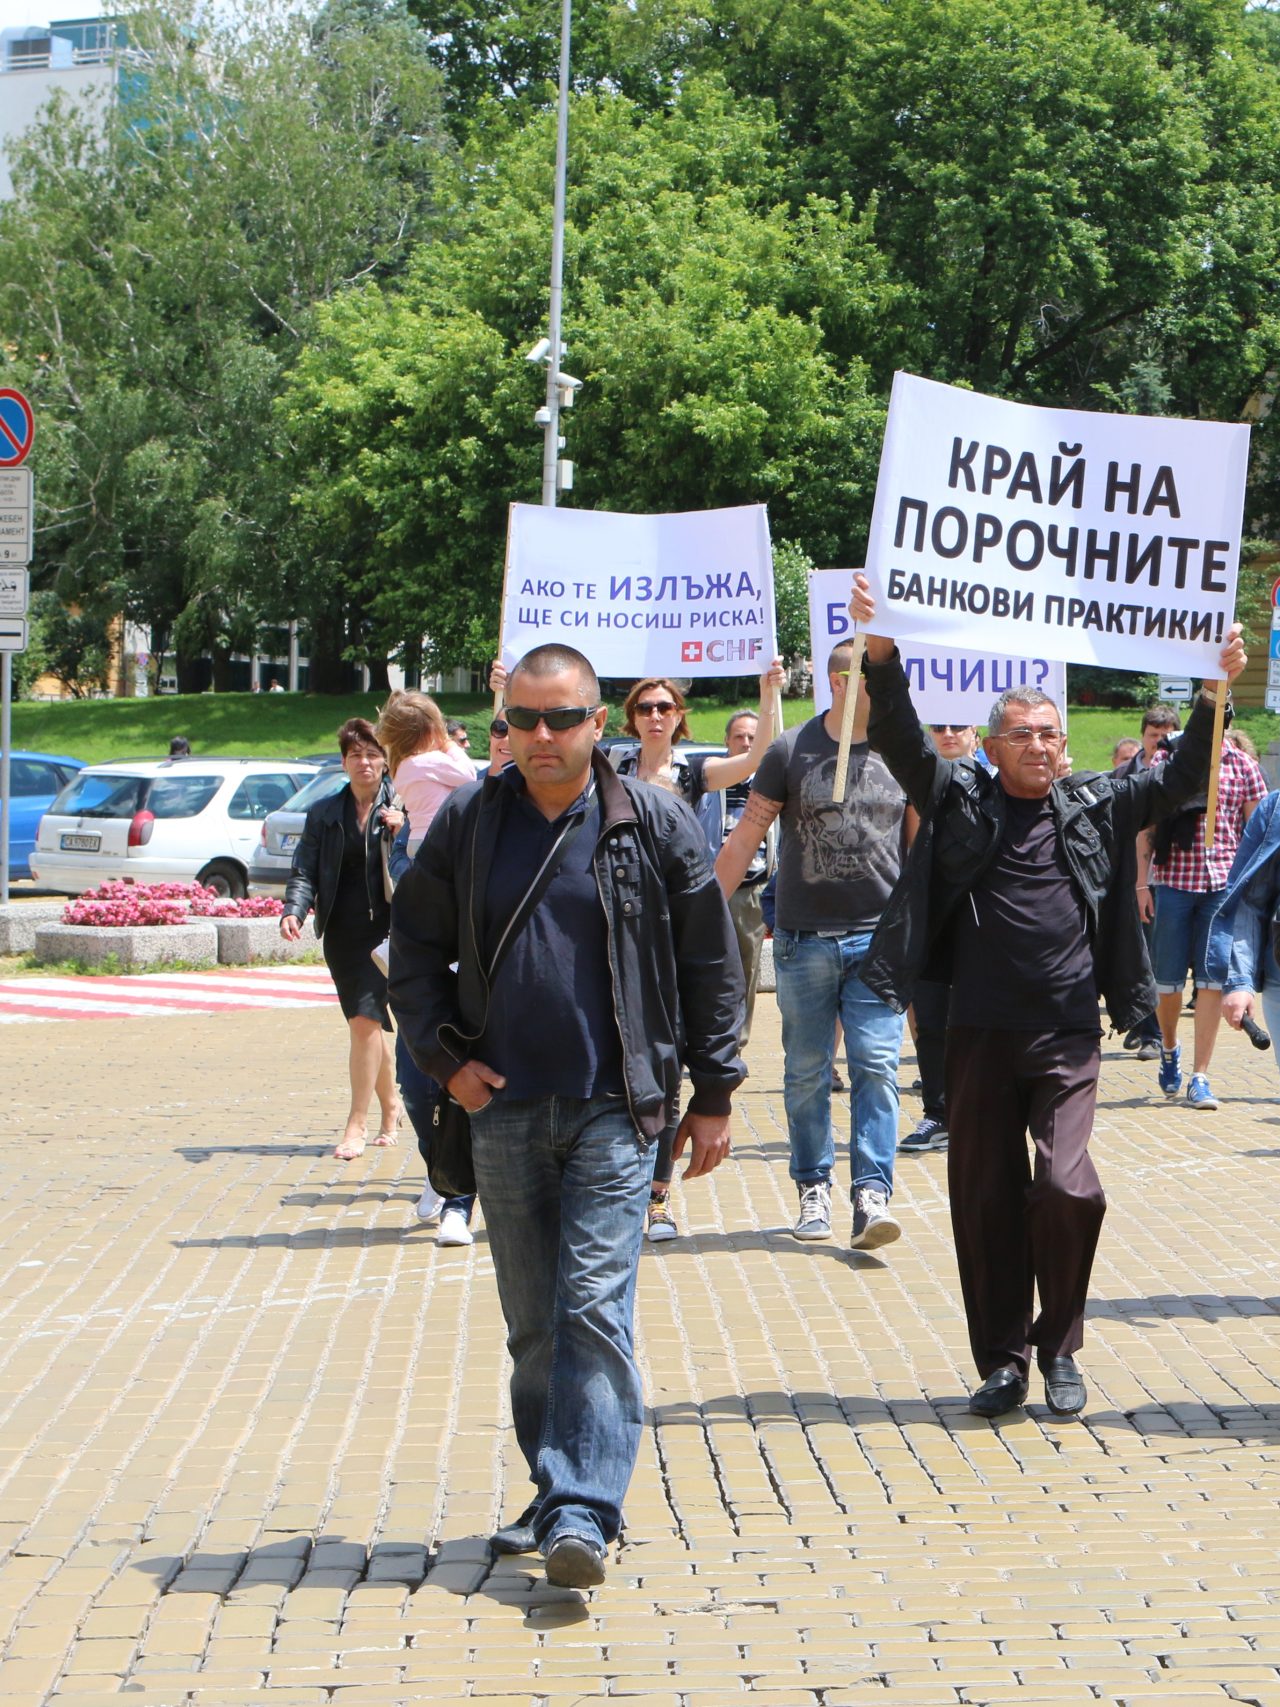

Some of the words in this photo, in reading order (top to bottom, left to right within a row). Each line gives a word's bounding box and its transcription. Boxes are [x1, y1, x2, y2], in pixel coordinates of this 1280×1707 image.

[948, 436, 1086, 509] КРАЙ
[1104, 461, 1181, 518] НА
[0, 528, 25, 536] АМЕНТ
[894, 496, 1230, 593] ПОРОЧНИТЕ
[520, 578, 565, 598] АКО
[572, 582, 596, 600] ТЕ
[609, 571, 762, 601] ИЗЛЪЖА,
[518, 607, 552, 628] ЩЕ
[560, 610, 588, 627] СИ
[597, 612, 682, 628] НОСИШ
[690, 607, 764, 628] РИСКА!
[887, 568, 1034, 622] БАНКОВИ
[1044, 594, 1225, 644] ПРАКТИКИ!
[706, 638, 763, 662] CHF
[905, 658, 1049, 693] ЛЧИШ?
